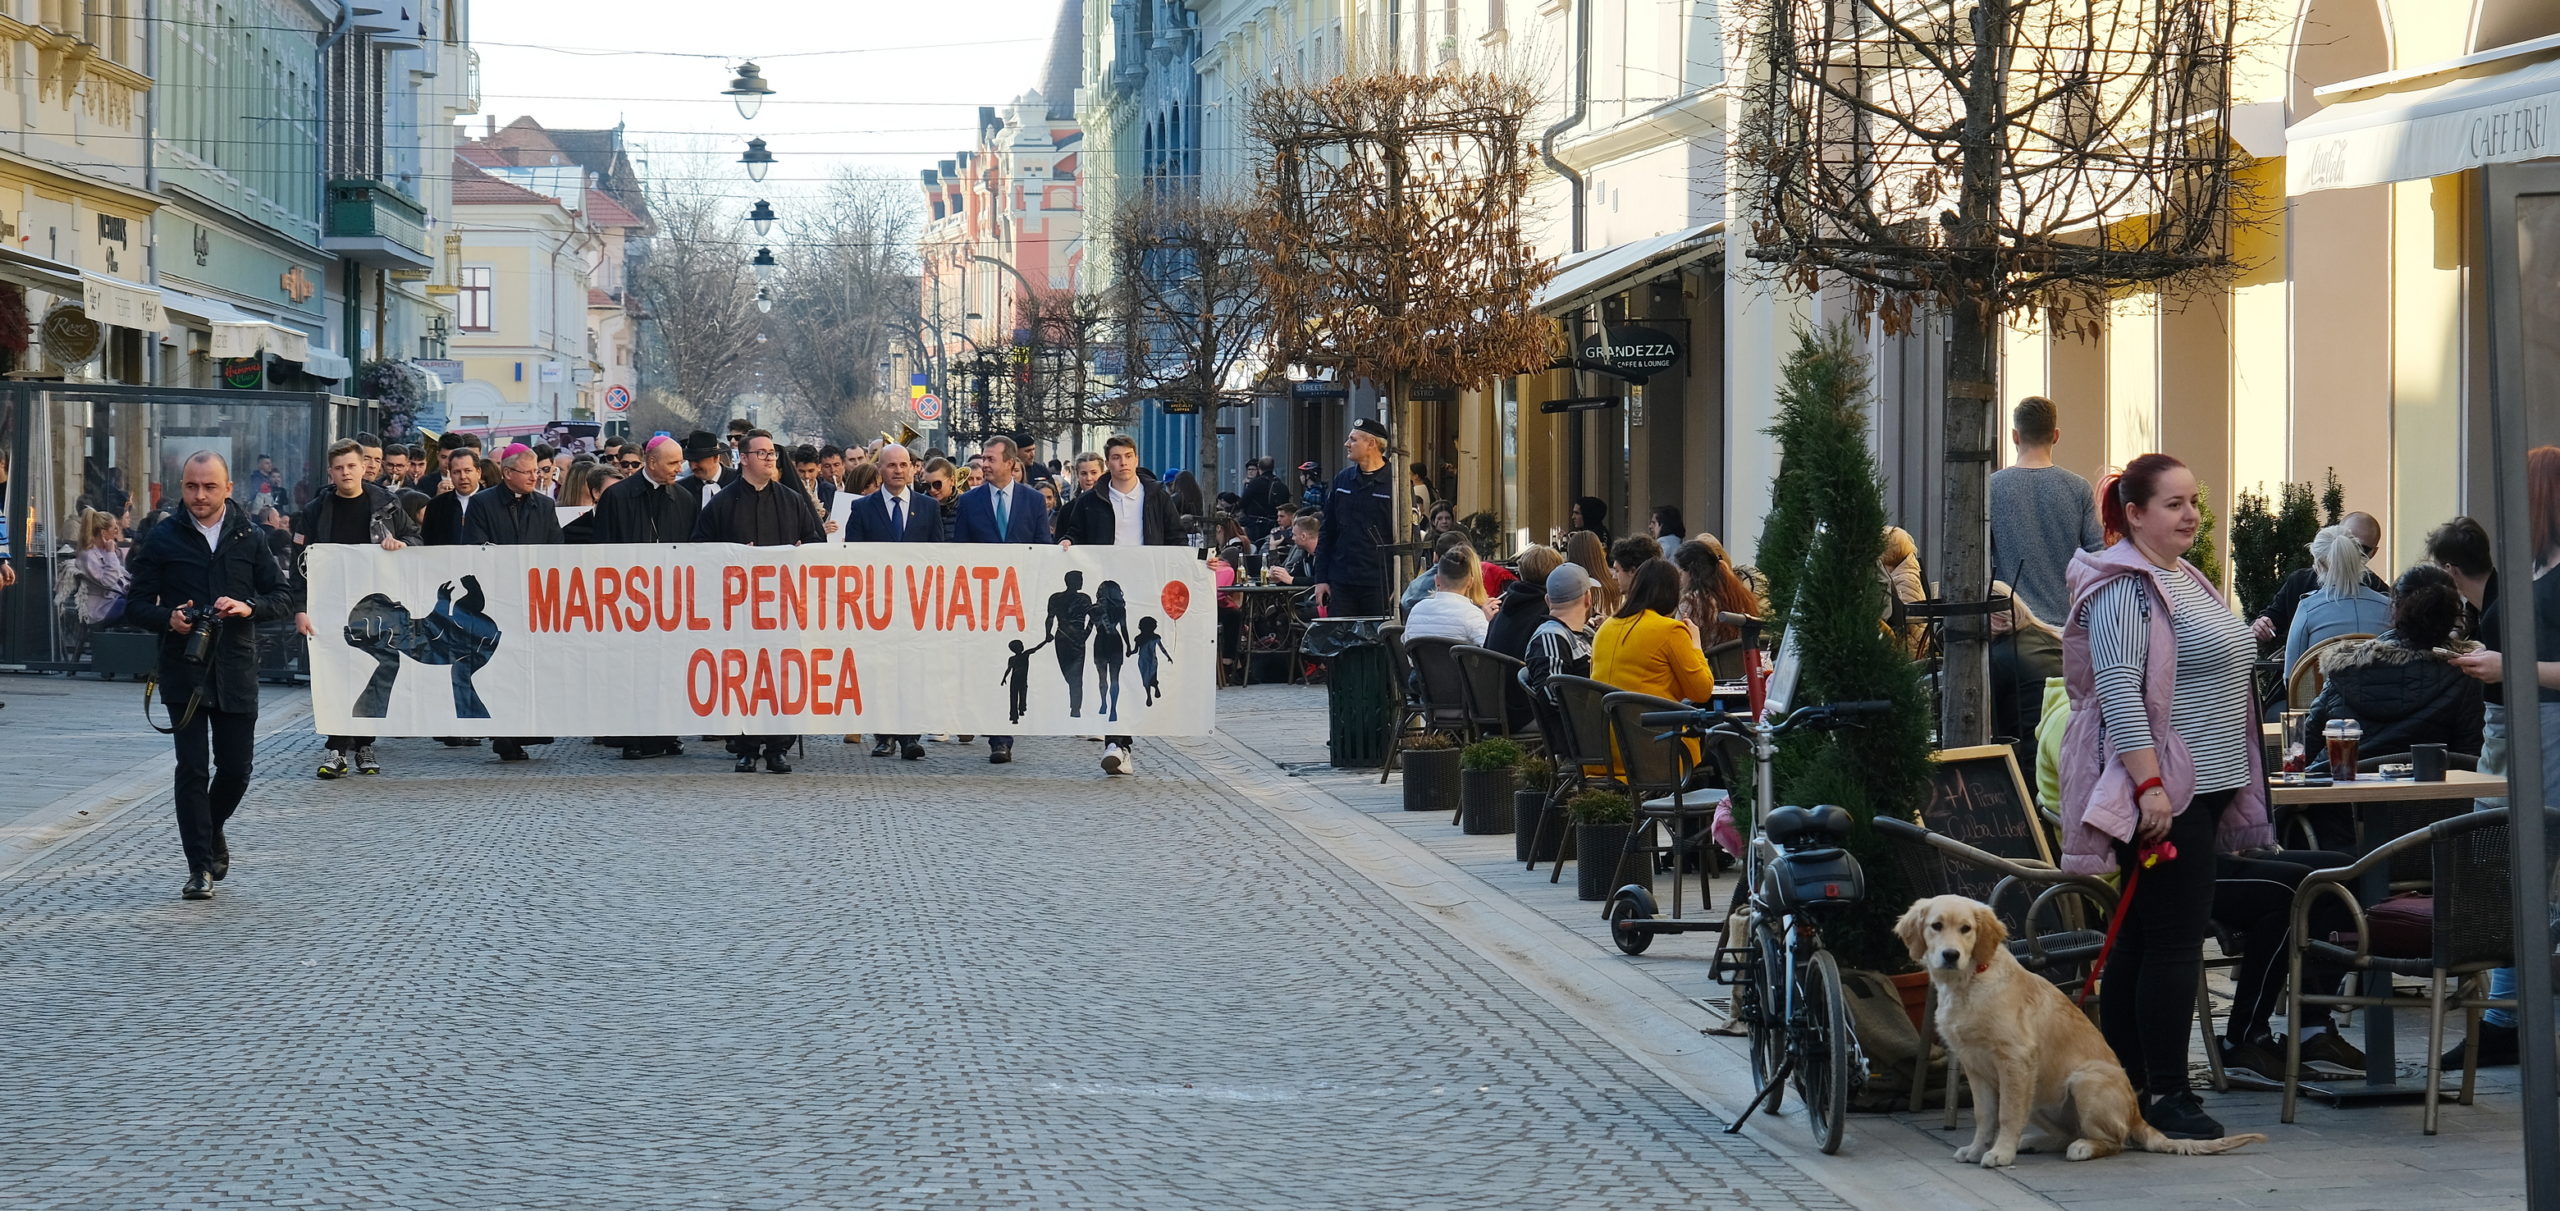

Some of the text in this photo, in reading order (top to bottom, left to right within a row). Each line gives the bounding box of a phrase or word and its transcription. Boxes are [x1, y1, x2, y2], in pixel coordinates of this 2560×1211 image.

[2471, 104, 2548, 159] CAFE FREI
[1585, 344, 1675, 359] GRANDEZZA
[1296, 383, 1322, 391] STREET
[528, 564, 1026, 632] MARSUL PENTRU VIATA
[687, 647, 863, 717] ORADEA
